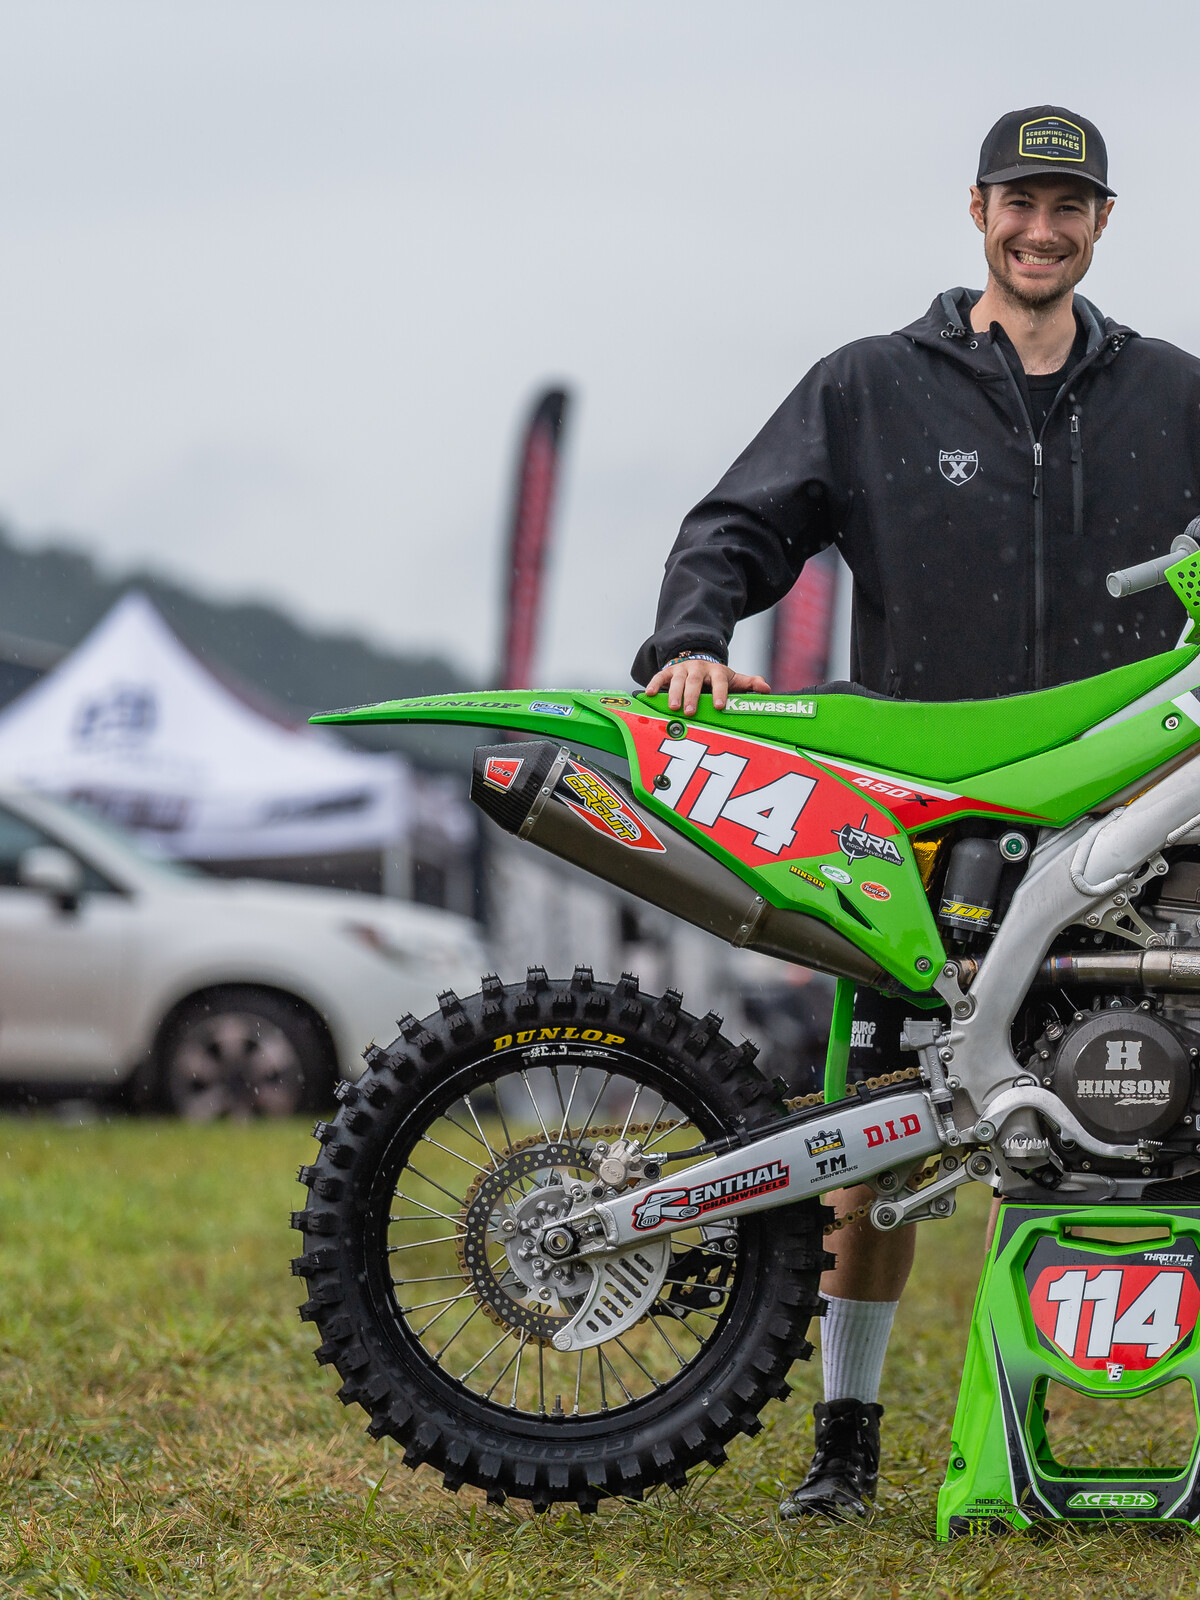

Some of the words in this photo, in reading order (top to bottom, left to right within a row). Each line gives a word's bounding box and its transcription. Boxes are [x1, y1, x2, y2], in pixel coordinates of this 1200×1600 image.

[1025, 130, 1080, 142] SCREAMING-FAST
[1025, 136, 1049, 146] DIRT
[1051, 137, 1080, 151] BIKES
[948, 461, 968, 479] X
[400, 700, 522, 710] DUNLOP
[725, 698, 814, 714] Kawasaki
[578, 773, 622, 810] PRO
[652, 737, 819, 856] 114
[565, 775, 637, 841] CIRCUIT
[845, 841, 863, 851] ROCK
[863, 848, 883, 858] RIVER
[848, 826, 902, 862] RRA
[790, 865, 826, 888] HINSON
[863, 884, 879, 895] Twin
[942, 901, 993, 920] JDP
[493, 1027, 625, 1052] DUNLOP
[1105, 1040, 1142, 1071] H
[1076, 1079, 1171, 1095] HINSON
[862, 1113, 922, 1148] D.I.D
[809, 1134, 839, 1150] DP
[810, 1164, 859, 1184] DESIGNWORKS
[815, 1153, 847, 1176] TM
[702, 1178, 787, 1210] CHAINWHEELS
[1143, 1253, 1195, 1263] THROTTLE
[1046, 1268, 1186, 1360] 114
